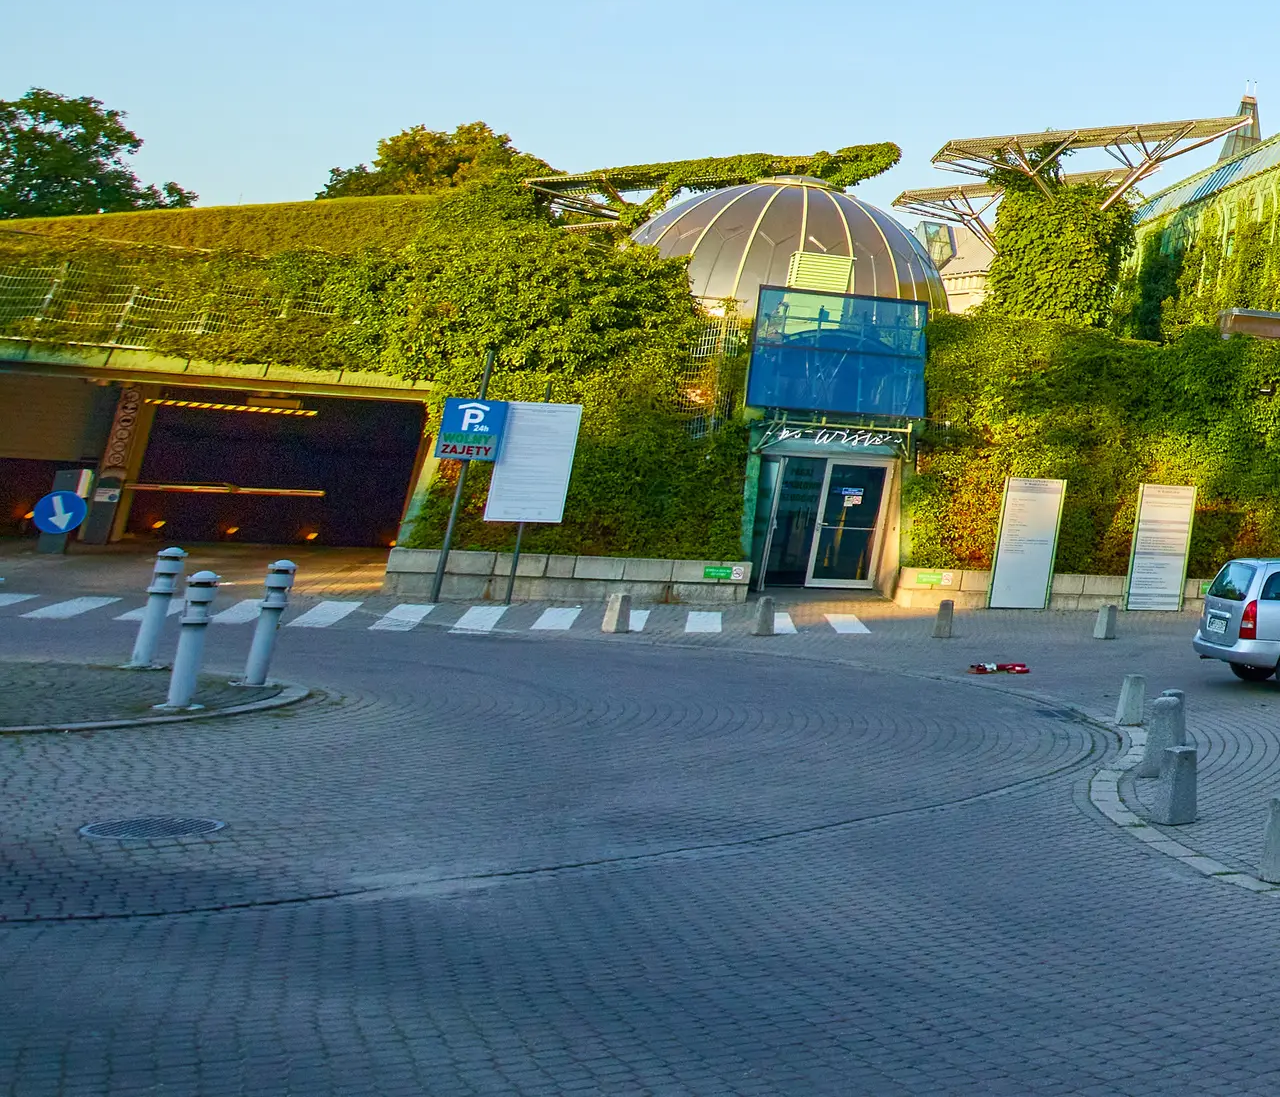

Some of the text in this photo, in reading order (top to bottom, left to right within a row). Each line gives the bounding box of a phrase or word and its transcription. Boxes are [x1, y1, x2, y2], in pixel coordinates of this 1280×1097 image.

[473, 424, 489, 432] 24h
[443, 433, 492, 445] WOLNY
[441, 445, 492, 457] ZAJĘTY
